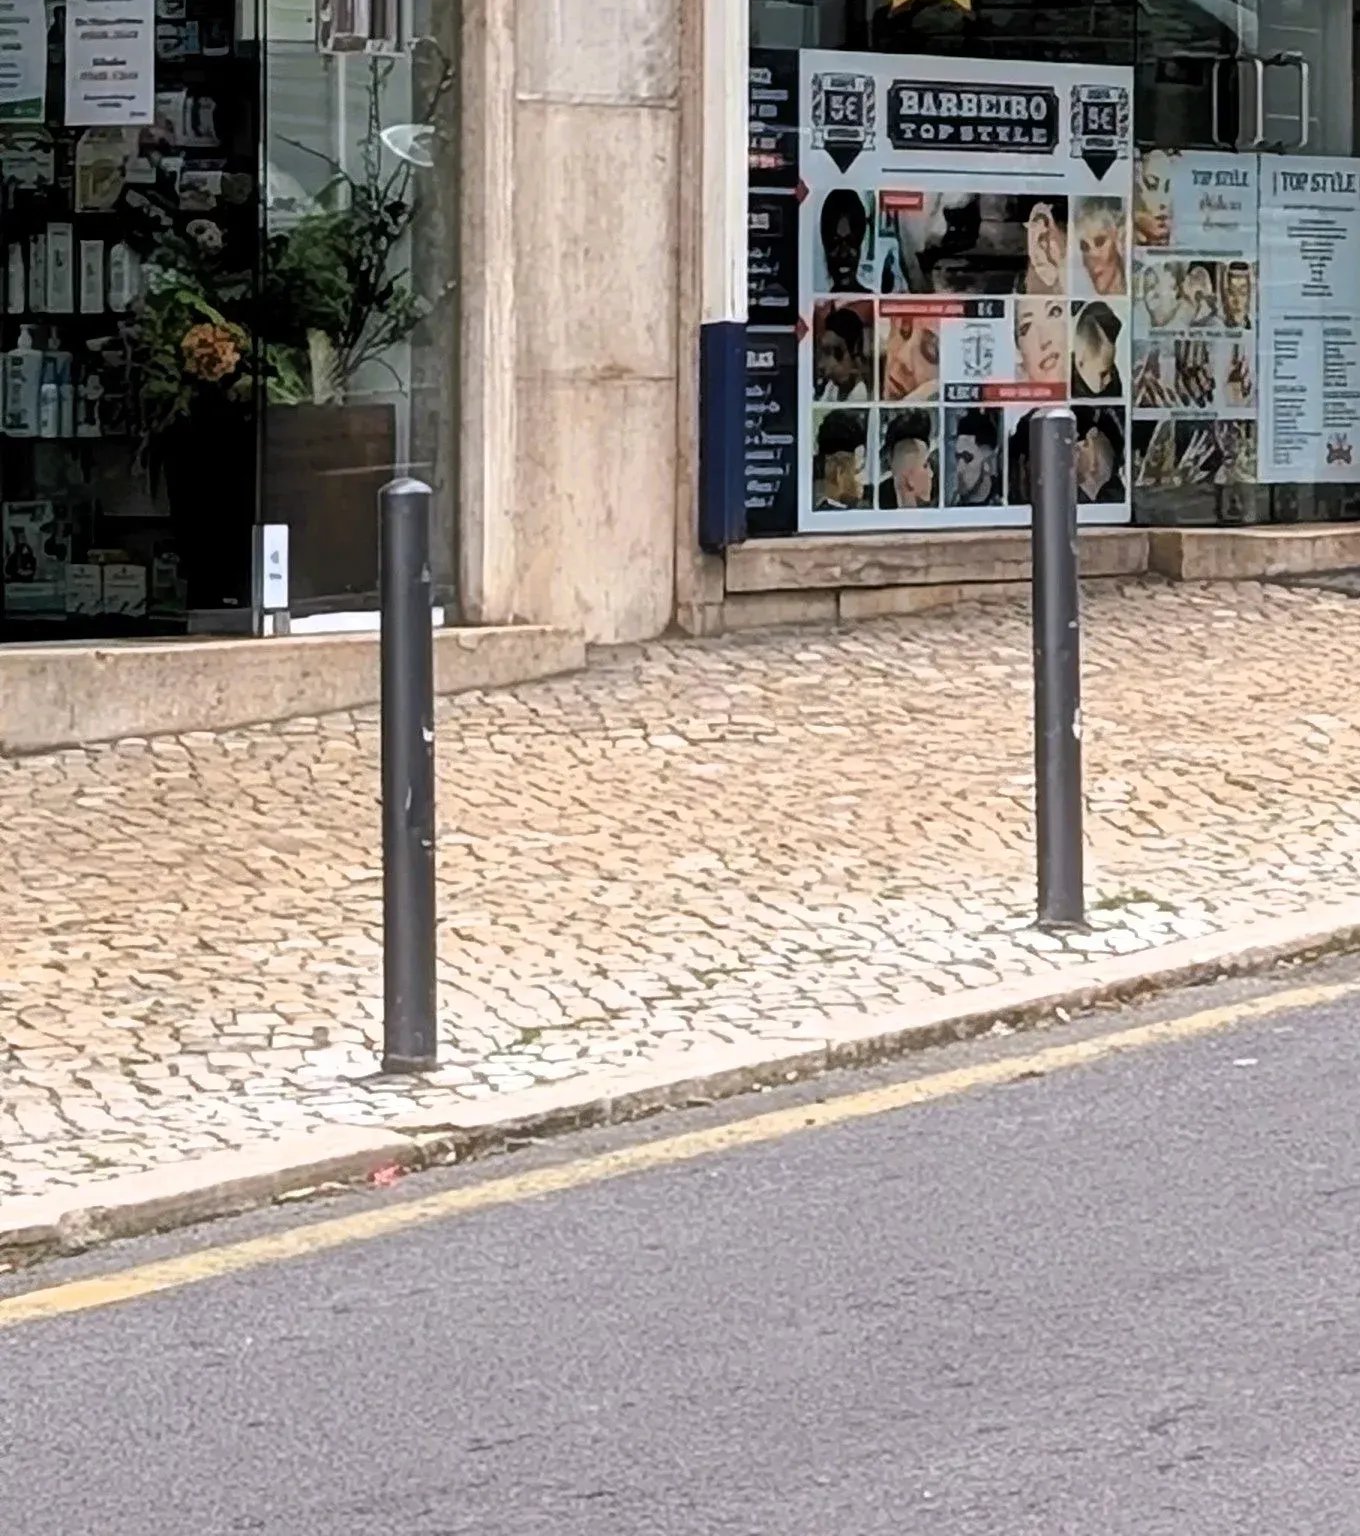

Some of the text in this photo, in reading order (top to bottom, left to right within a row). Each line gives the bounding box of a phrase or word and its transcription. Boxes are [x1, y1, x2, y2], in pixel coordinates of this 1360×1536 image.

[900, 91, 1047, 120] BARBEIRO
[900, 123, 1048, 145] TOP STYLE
[1281, 171, 1357, 195] TOP STYLE
